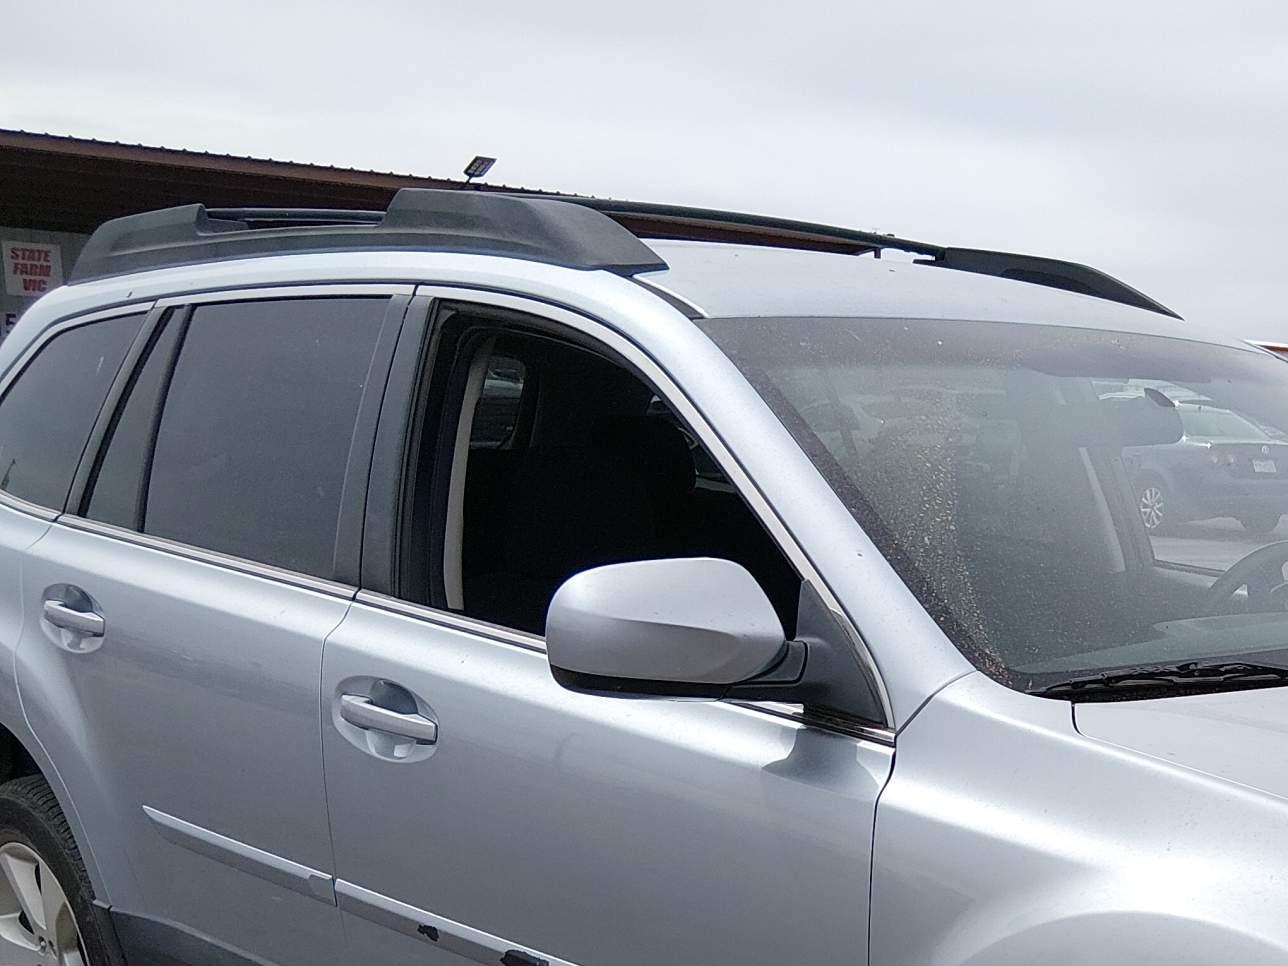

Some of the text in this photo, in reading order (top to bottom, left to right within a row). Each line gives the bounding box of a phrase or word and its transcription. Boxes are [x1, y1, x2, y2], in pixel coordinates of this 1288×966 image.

[10, 247, 51, 263] STATE
[13, 262, 51, 277] FARM
[22, 278, 48, 292] VIC
